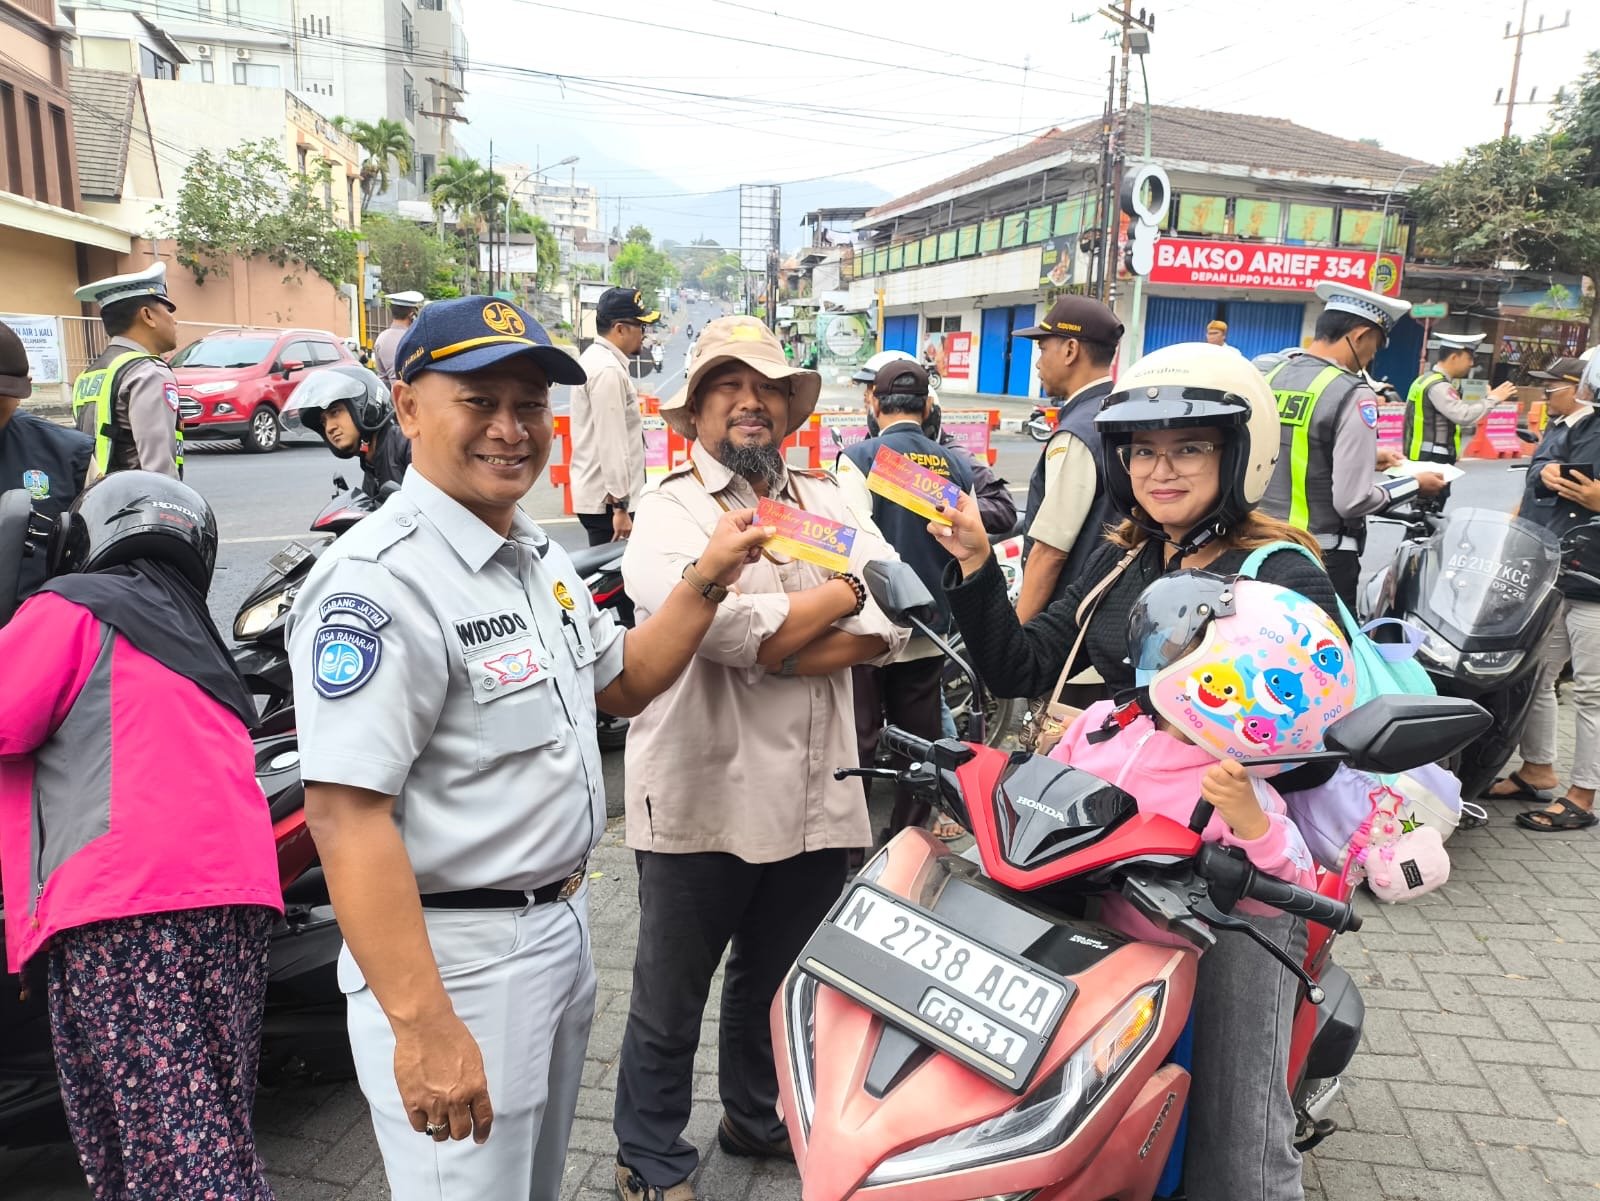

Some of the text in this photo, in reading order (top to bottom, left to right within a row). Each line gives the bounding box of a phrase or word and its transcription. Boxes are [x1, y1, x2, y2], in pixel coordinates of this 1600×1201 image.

[1157, 244, 1244, 271] BAKSO
[1248, 250, 1321, 276] ARIEF
[1323, 256, 1366, 279] 354
[1190, 271, 1228, 282] DEPAN
[1229, 273, 1261, 284] LIPPO
[1262, 275, 1297, 287] PLAZA
[1305, 278, 1321, 289] BA
[821, 433, 865, 446] smrtfre
[911, 472, 945, 500] 10%
[152, 501, 199, 522] HONDA
[801, 520, 840, 545] 10%
[322, 598, 383, 624] CABANG JATIM
[455, 612, 528, 647] WIDODO
[1259, 626, 1285, 644] DOO
[318, 632, 376, 653] JASA RAHARJA
[1183, 707, 1204, 729] DOO
[1016, 795, 1065, 823] HONDA
[843, 896, 1050, 1026] N 2738 ACA
[1137, 1091, 1177, 1160] HONDA
